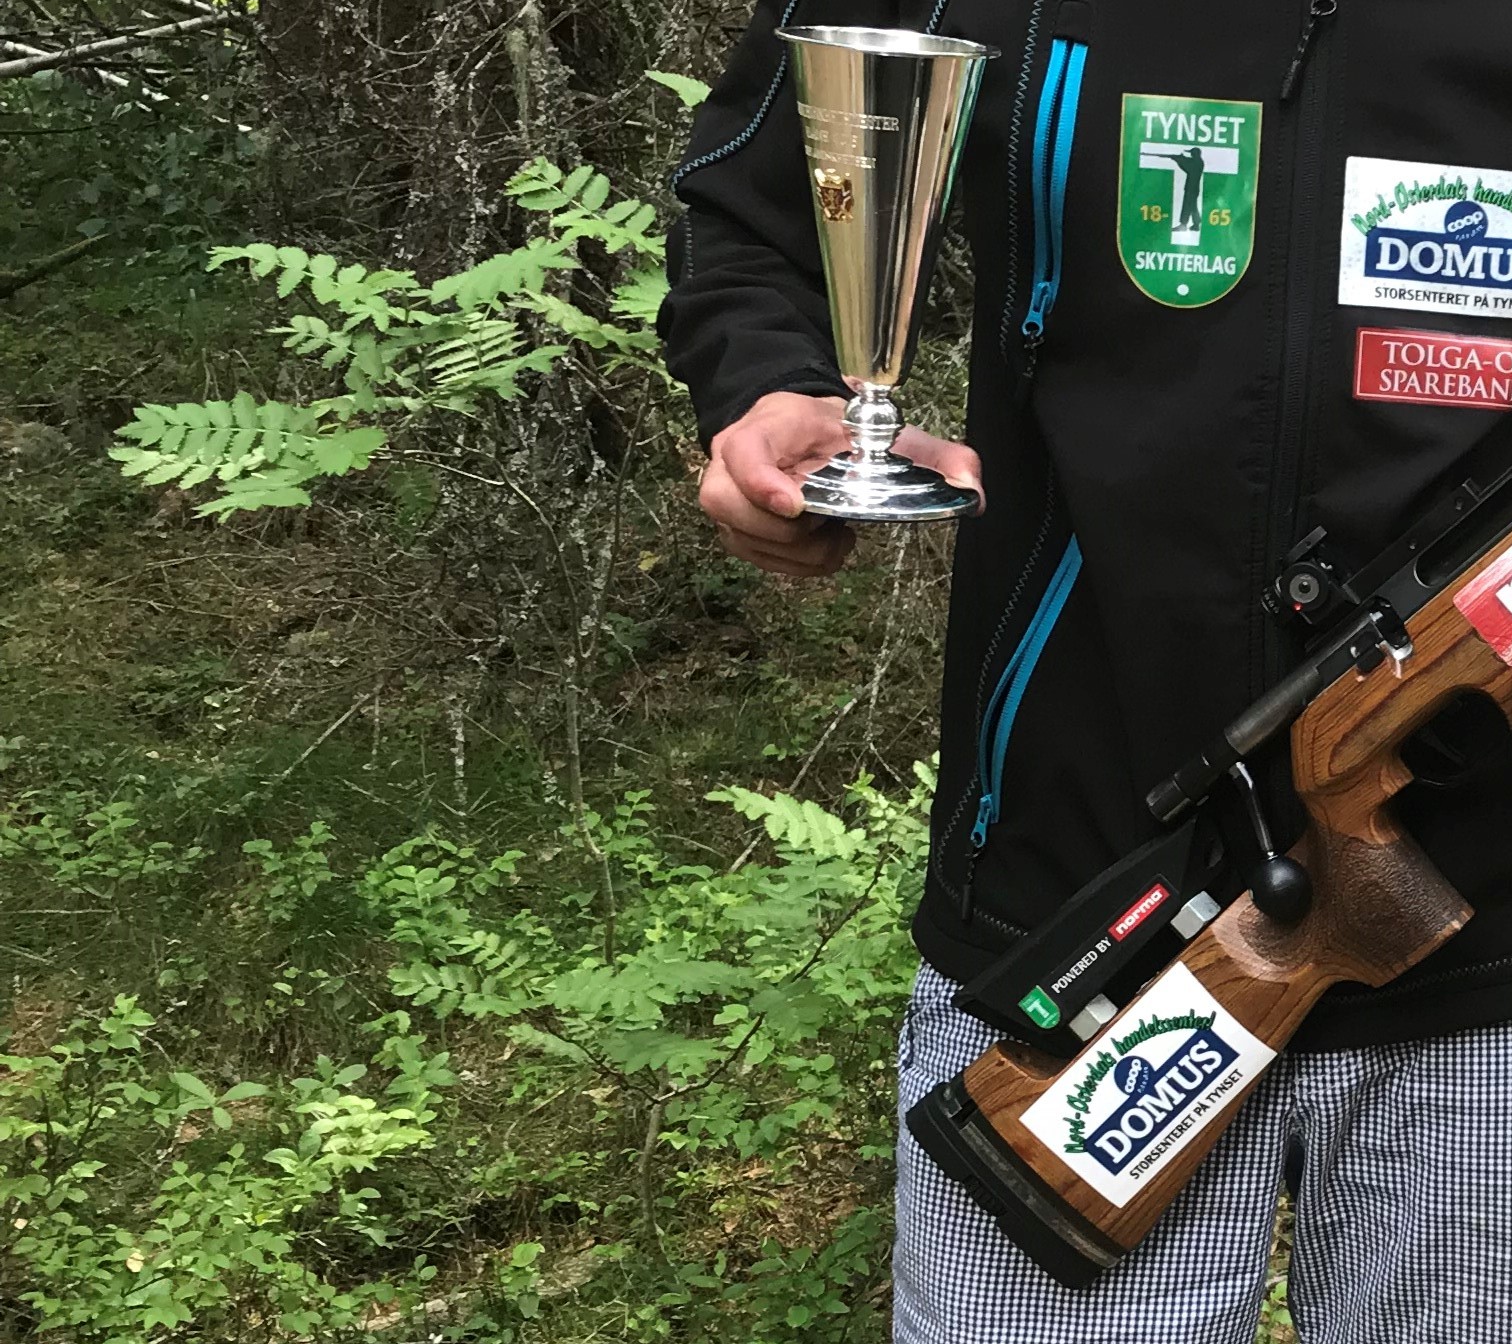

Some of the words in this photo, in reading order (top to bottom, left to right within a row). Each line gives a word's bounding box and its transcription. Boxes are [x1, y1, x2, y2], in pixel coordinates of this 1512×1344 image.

[1141, 111, 1245, 145] TYNSET
[1208, 209, 1231, 226] 65
[1446, 210, 1484, 233] coop
[1135, 250, 1236, 276] SKYTTERLAG
[1374, 286, 1469, 307] STORSENTERET
[1473, 293, 1489, 308] PÅ
[1050, 950, 1100, 994] POWERED
[1096, 936, 1113, 955] BY
[1113, 889, 1164, 938] norma
[1123, 1057, 1143, 1096] coop
[1095, 1040, 1223, 1164] DOMUS
[1128, 1115, 1194, 1180] STORSENTERET
[1193, 1097, 1210, 1118] PÅ
[1206, 1068, 1244, 1106] TYNSET
